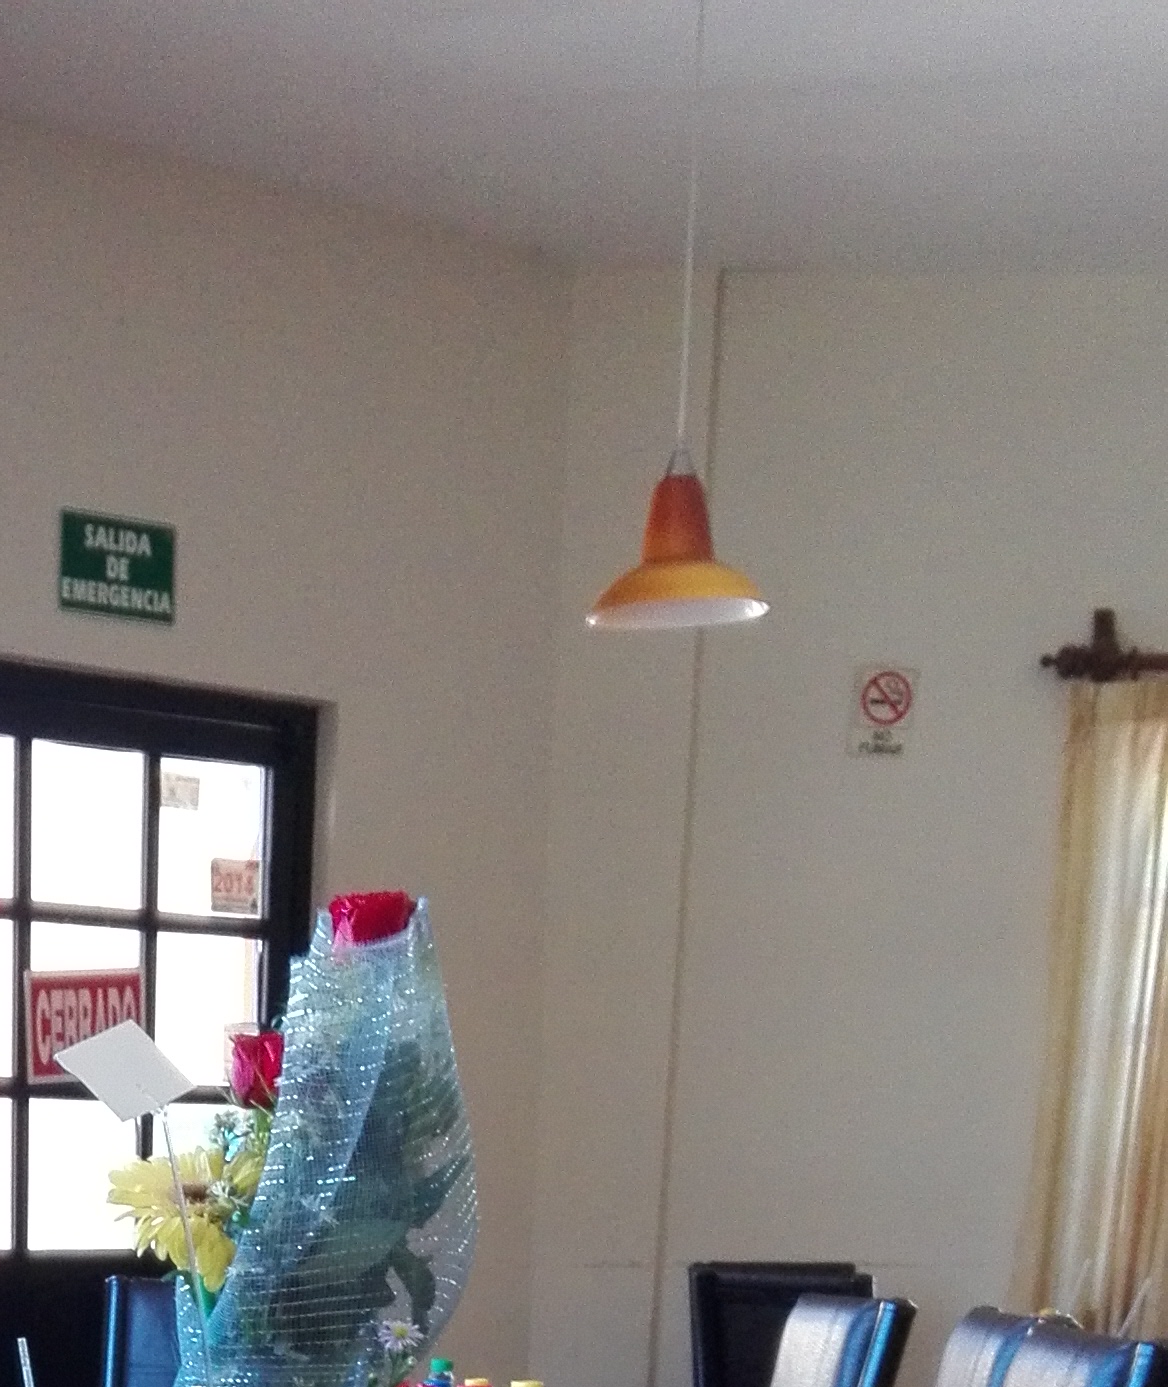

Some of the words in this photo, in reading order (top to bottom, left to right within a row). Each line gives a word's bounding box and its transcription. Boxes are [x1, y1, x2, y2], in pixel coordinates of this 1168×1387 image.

[83, 523, 151, 558] SALIDA
[106, 554, 130, 581] DE
[61, 576, 171, 614] EMERGENCIA
